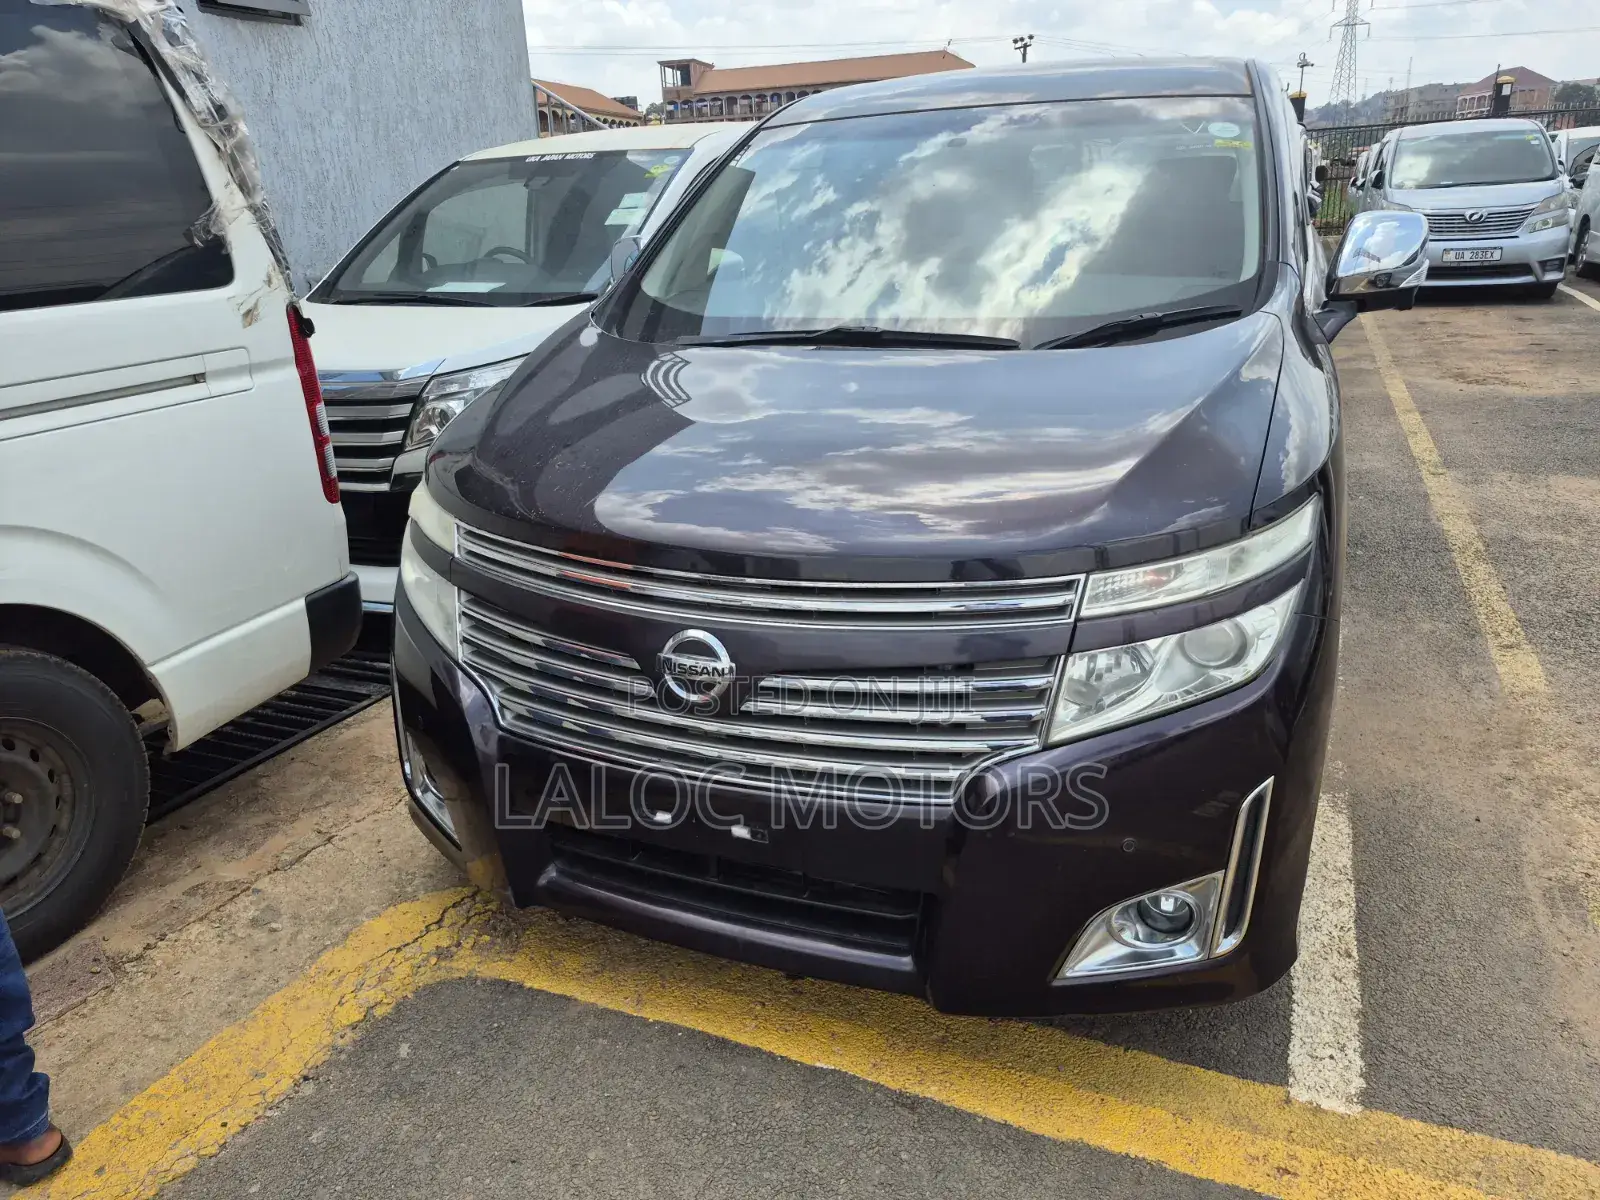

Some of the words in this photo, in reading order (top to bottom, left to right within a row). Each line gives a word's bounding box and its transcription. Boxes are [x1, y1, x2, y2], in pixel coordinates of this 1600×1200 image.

[540, 153, 565, 161] JAPAN
[563, 152, 596, 160] MOTORS
[1454, 251, 1464, 260] UA
[1469, 250, 1495, 260] 283EX
[662, 656, 726, 678] NISSAN
